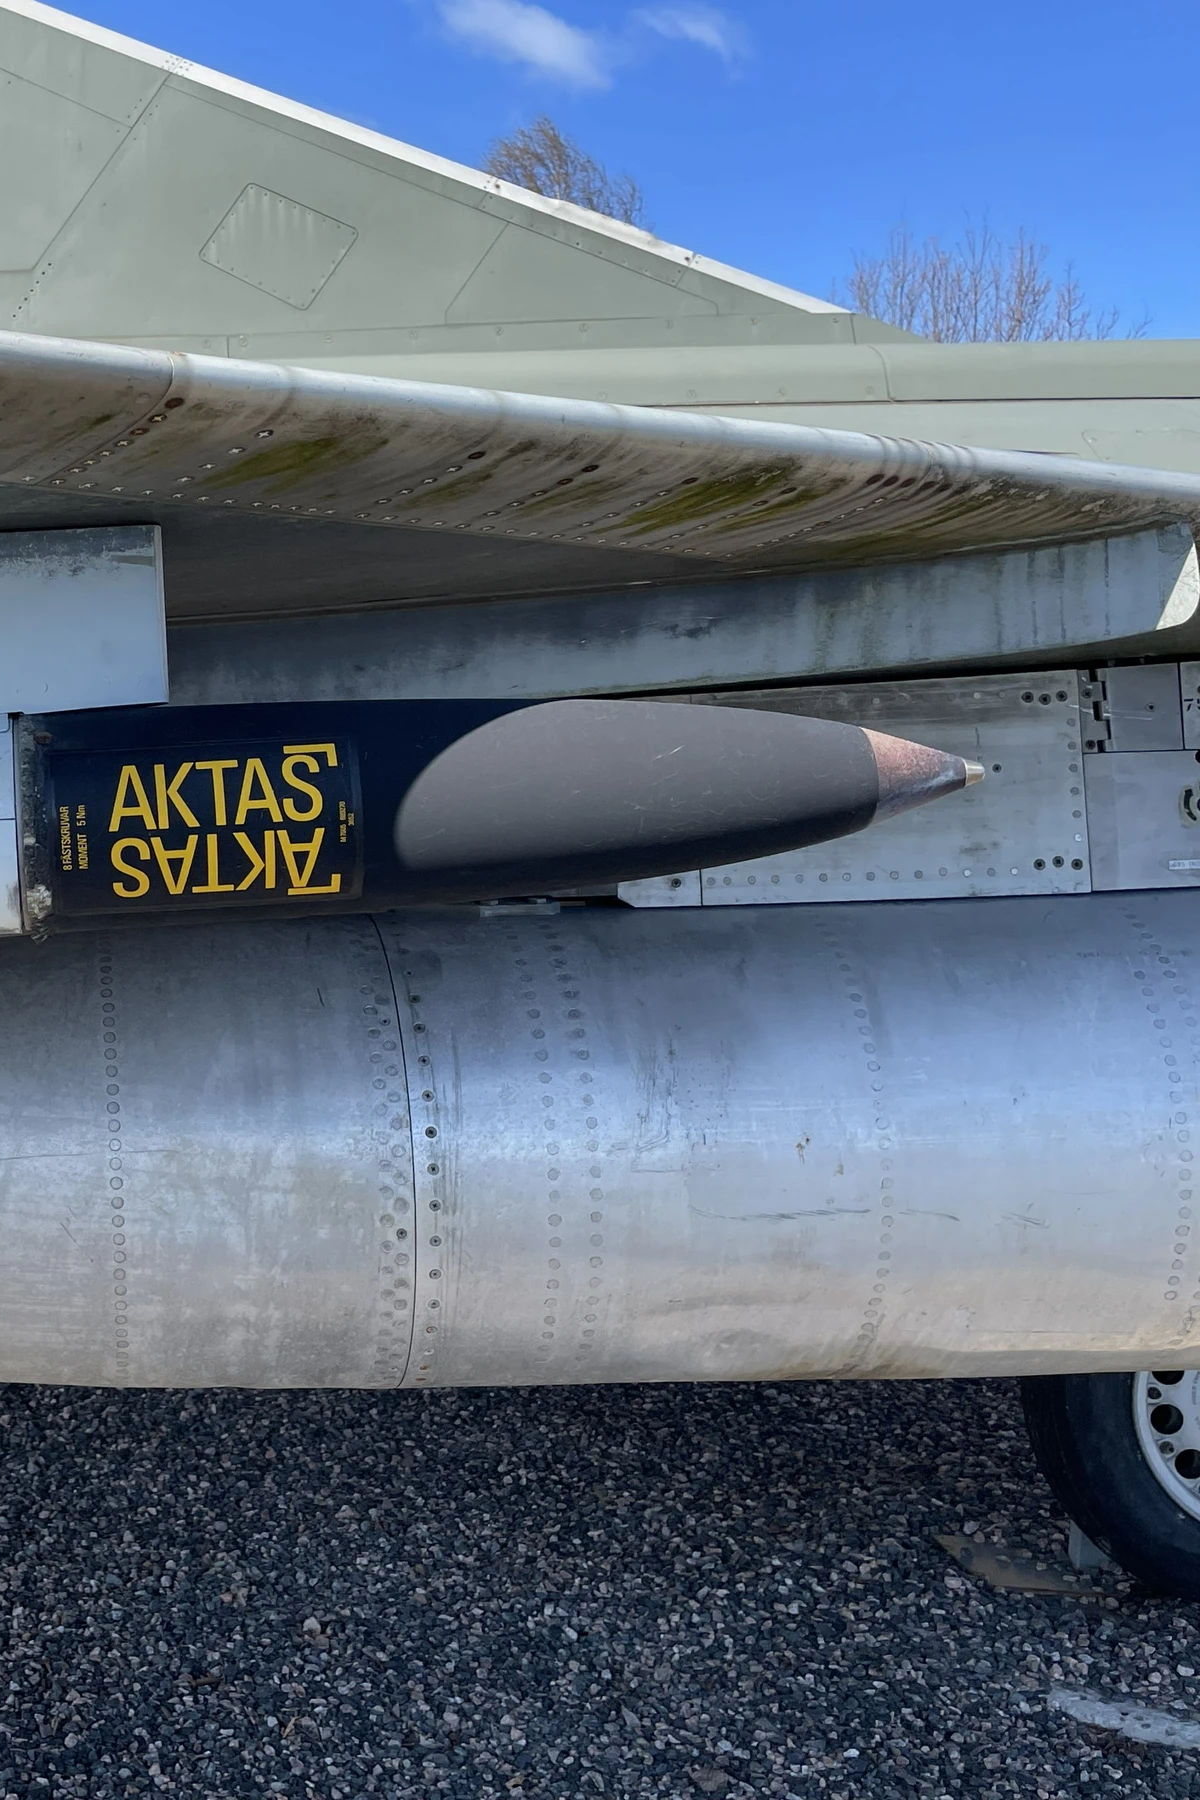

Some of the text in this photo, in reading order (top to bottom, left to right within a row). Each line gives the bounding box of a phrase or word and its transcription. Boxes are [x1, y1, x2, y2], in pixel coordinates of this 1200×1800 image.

[76, 804, 86, 819] Nm
[109, 754, 324, 832] AKTAS
[60, 806, 72, 864] FÄSTSKRUVAR
[77, 833, 89, 869] MOMENT
[111, 827, 326, 898] AKTAS
